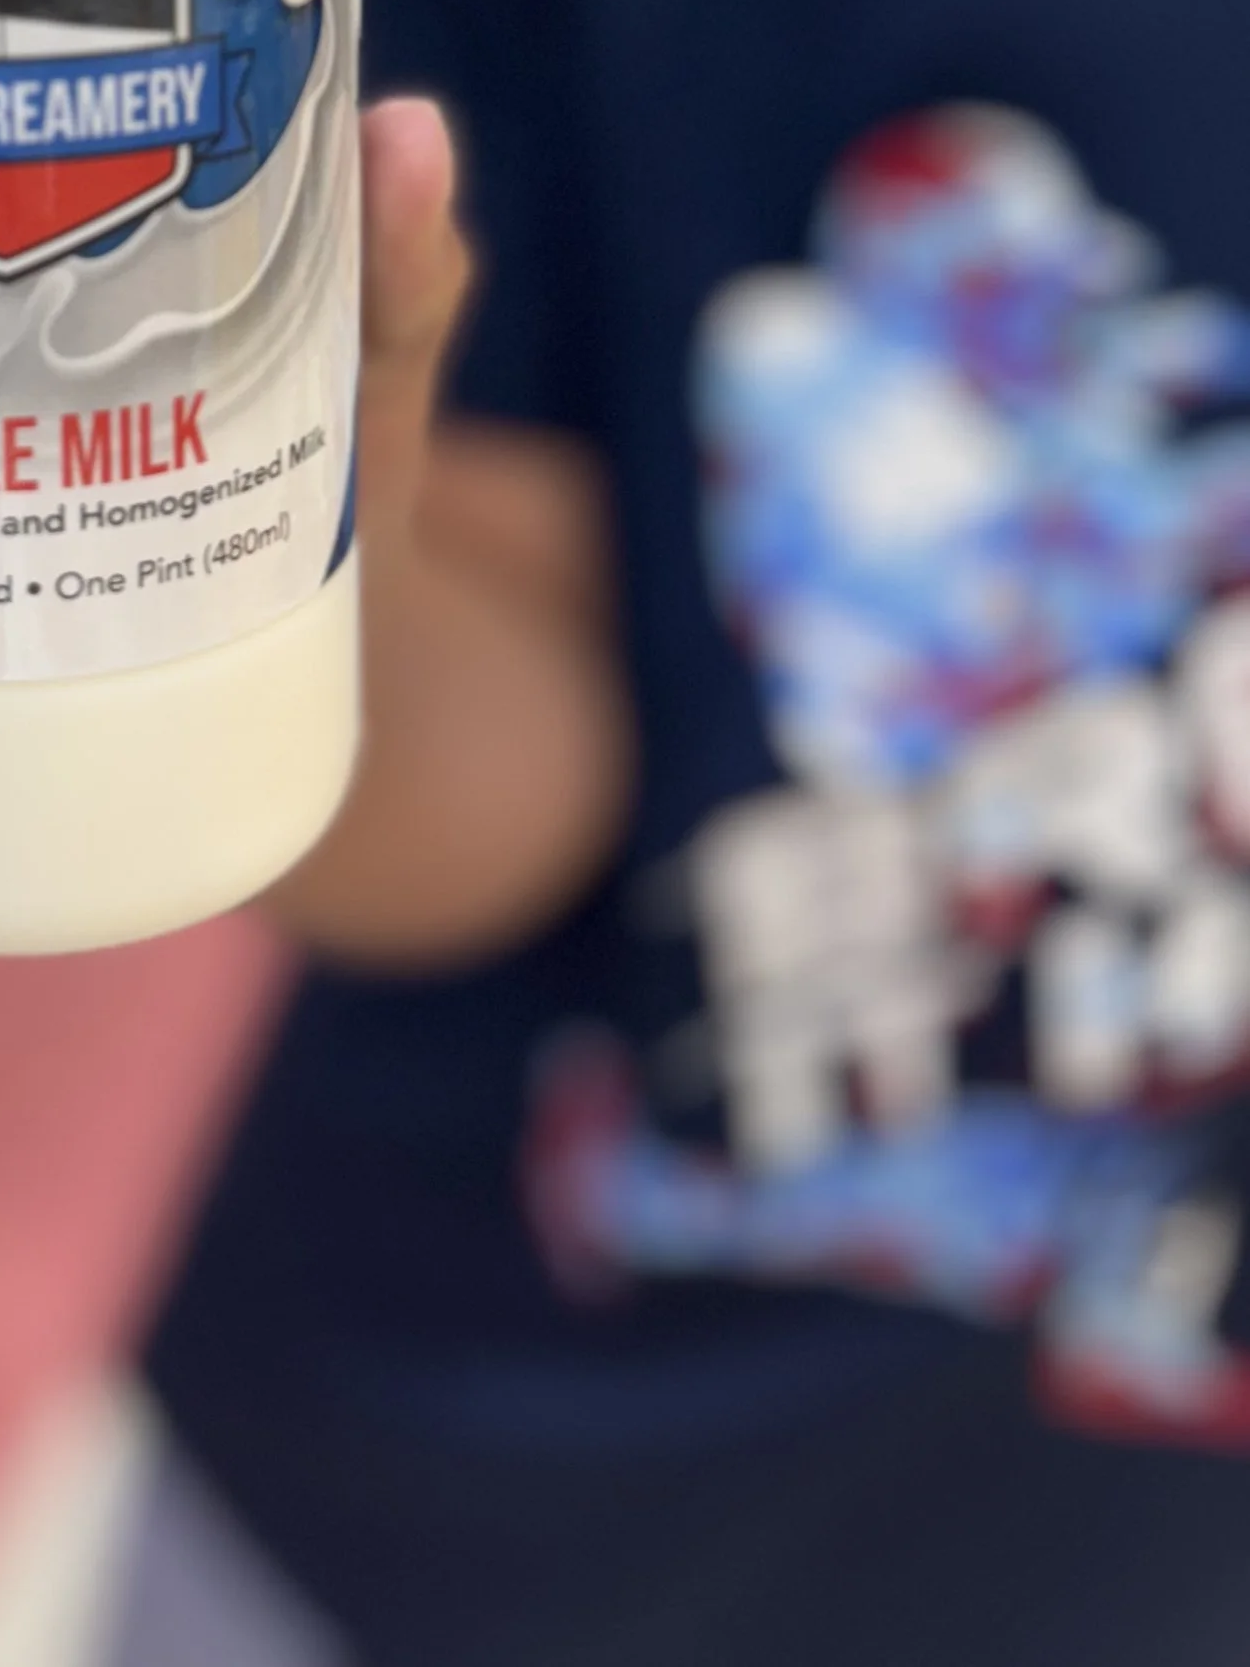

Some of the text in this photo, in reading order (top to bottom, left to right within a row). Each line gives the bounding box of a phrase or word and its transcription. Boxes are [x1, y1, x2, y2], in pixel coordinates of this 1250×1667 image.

[0, 506, 65, 537] and
[80, 450, 283, 530] Homogenized
[288, 426, 326, 470] Milk
[60, 390, 208, 488] MILK
[55, 570, 126, 600] One
[137, 552, 194, 588] Pint
[202, 511, 291, 575] (480ml)
